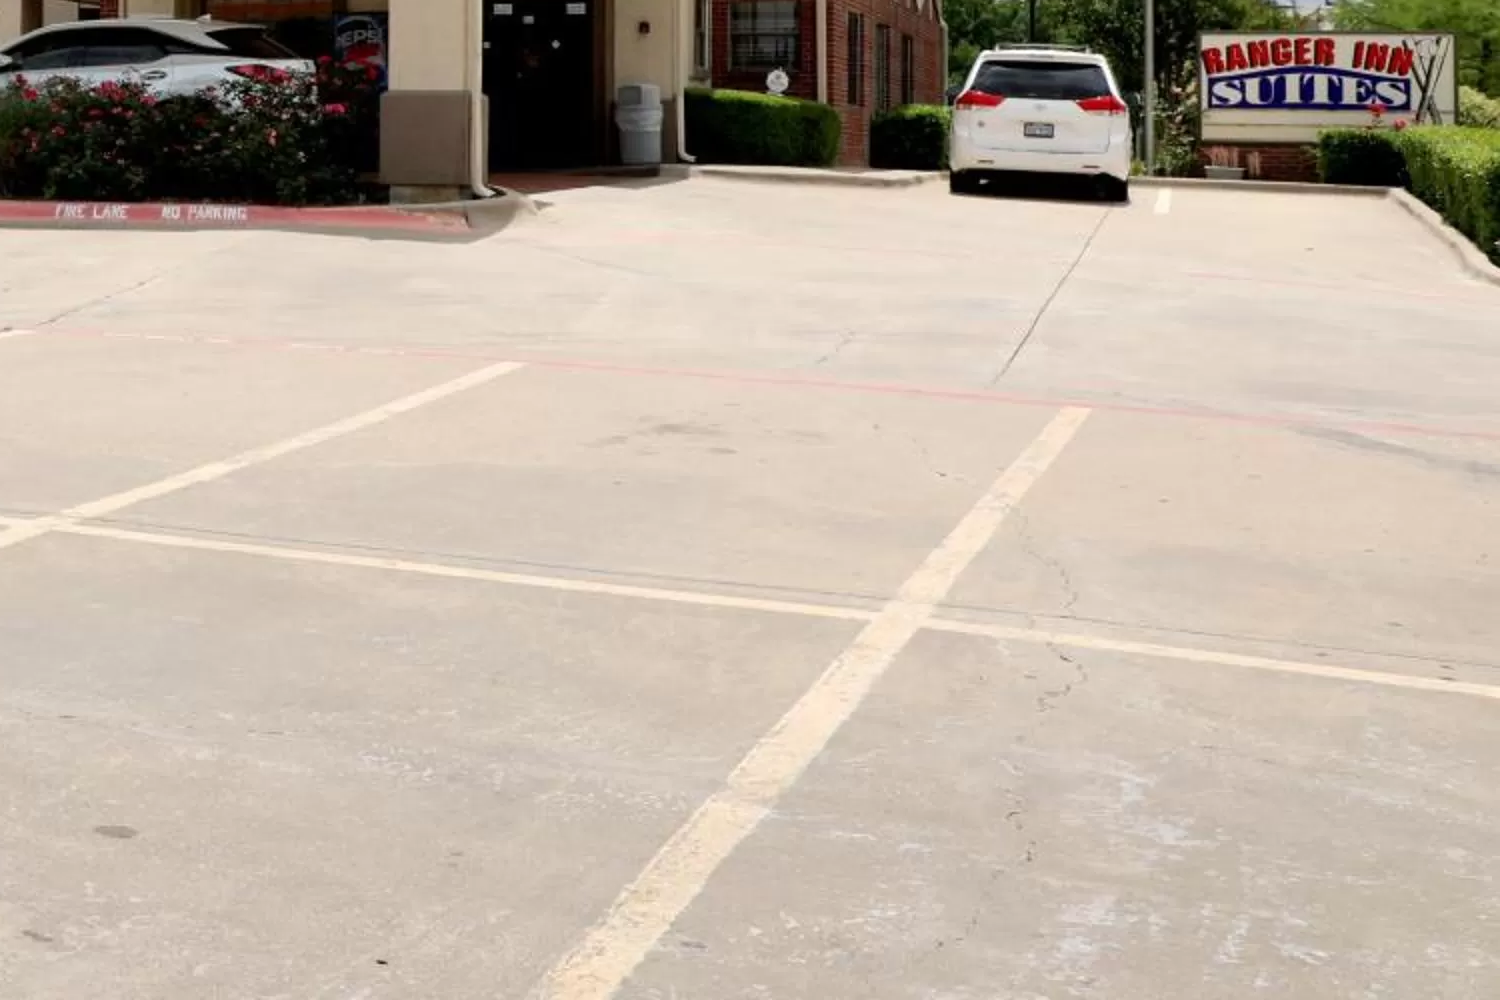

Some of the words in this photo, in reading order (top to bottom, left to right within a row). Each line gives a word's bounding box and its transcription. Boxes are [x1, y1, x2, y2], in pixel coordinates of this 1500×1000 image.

[1201, 38, 1335, 74] RANGER
[1352, 40, 1413, 76] INN
[1211, 74, 1408, 106] SUITES
[55, 204, 85, 219] FIRE
[93, 204, 131, 219] LANE
[161, 205, 181, 219] NO
[187, 206, 248, 220] PARKING
